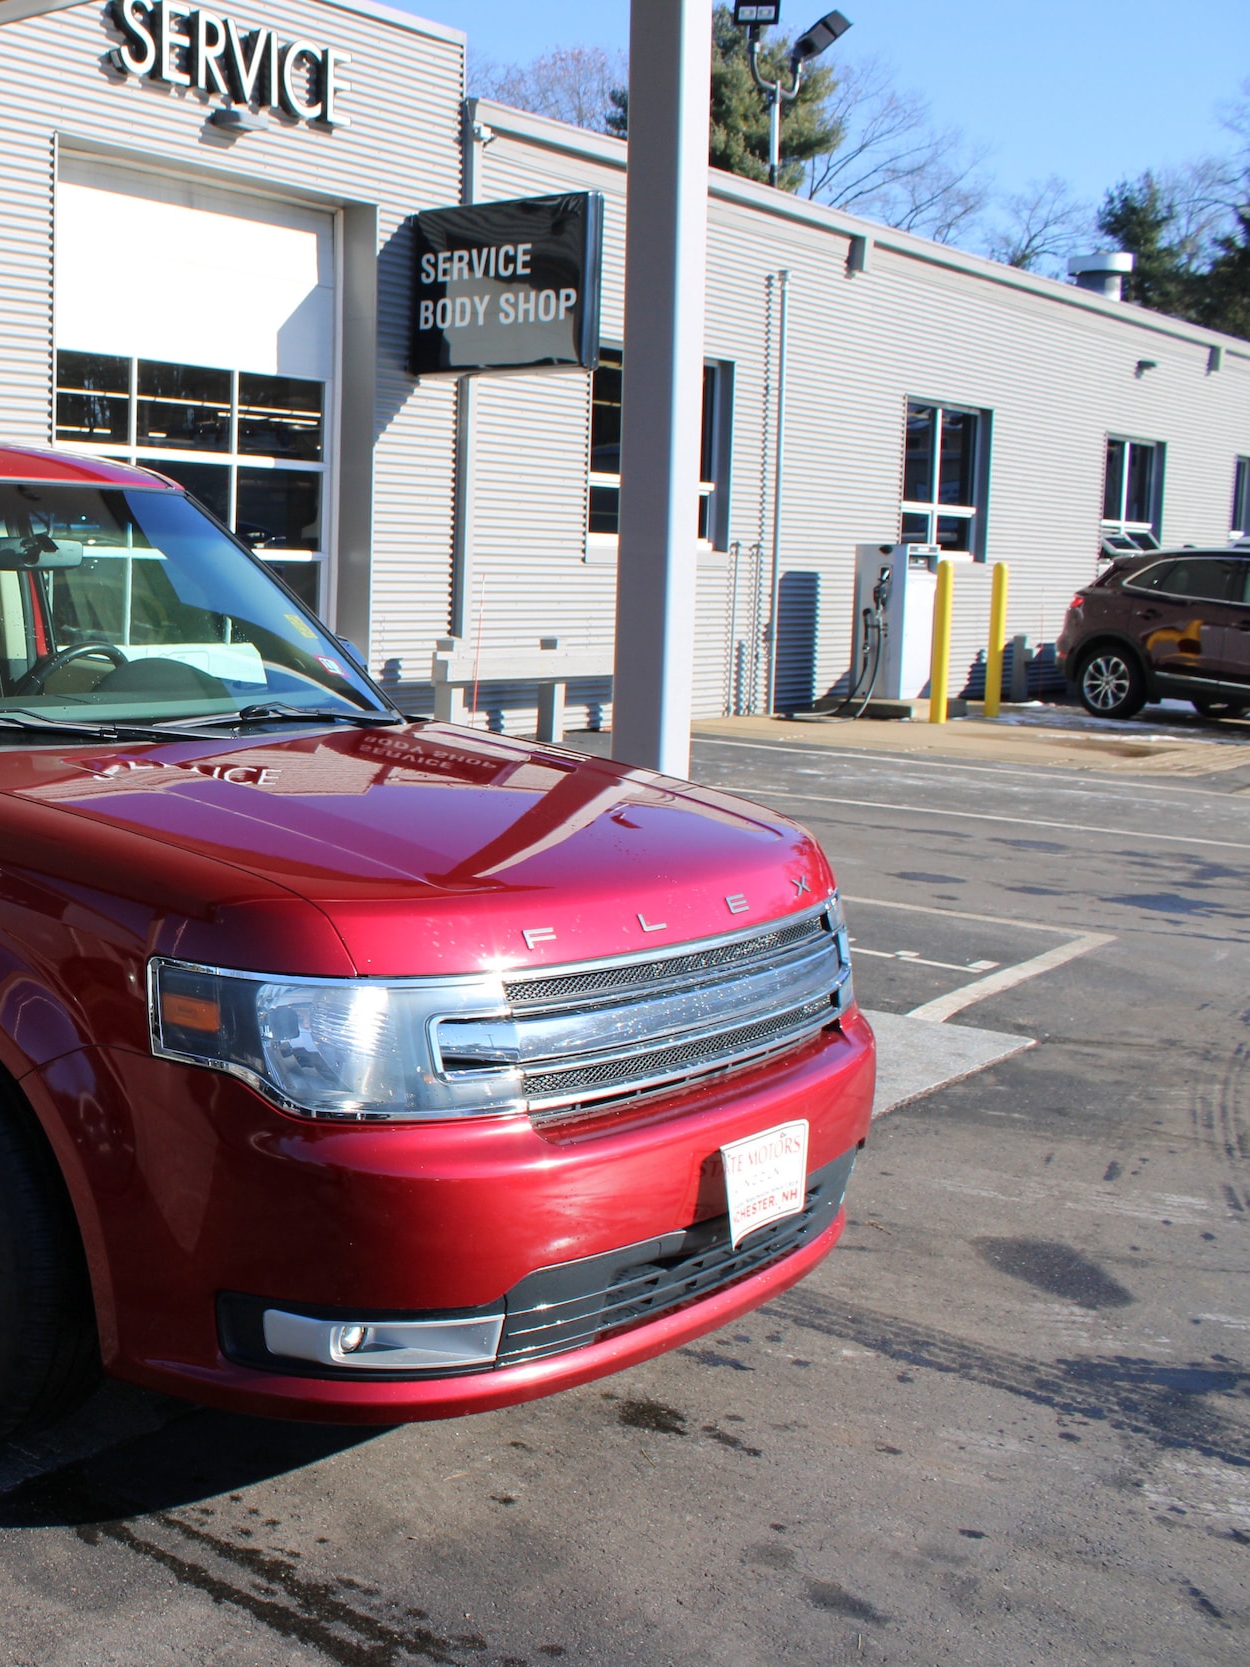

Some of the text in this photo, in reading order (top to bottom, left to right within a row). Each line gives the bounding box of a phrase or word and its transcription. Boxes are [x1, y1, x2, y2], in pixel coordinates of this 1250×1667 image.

[119, 0, 352, 126] SERVICE
[420, 243, 533, 285] SERVICE
[419, 288, 578, 331] BODY SHOP
[521, 875, 811, 950] FLEX
[748, 1135, 801, 1166] MOTORS
[782, 1187, 798, 1202] NH
